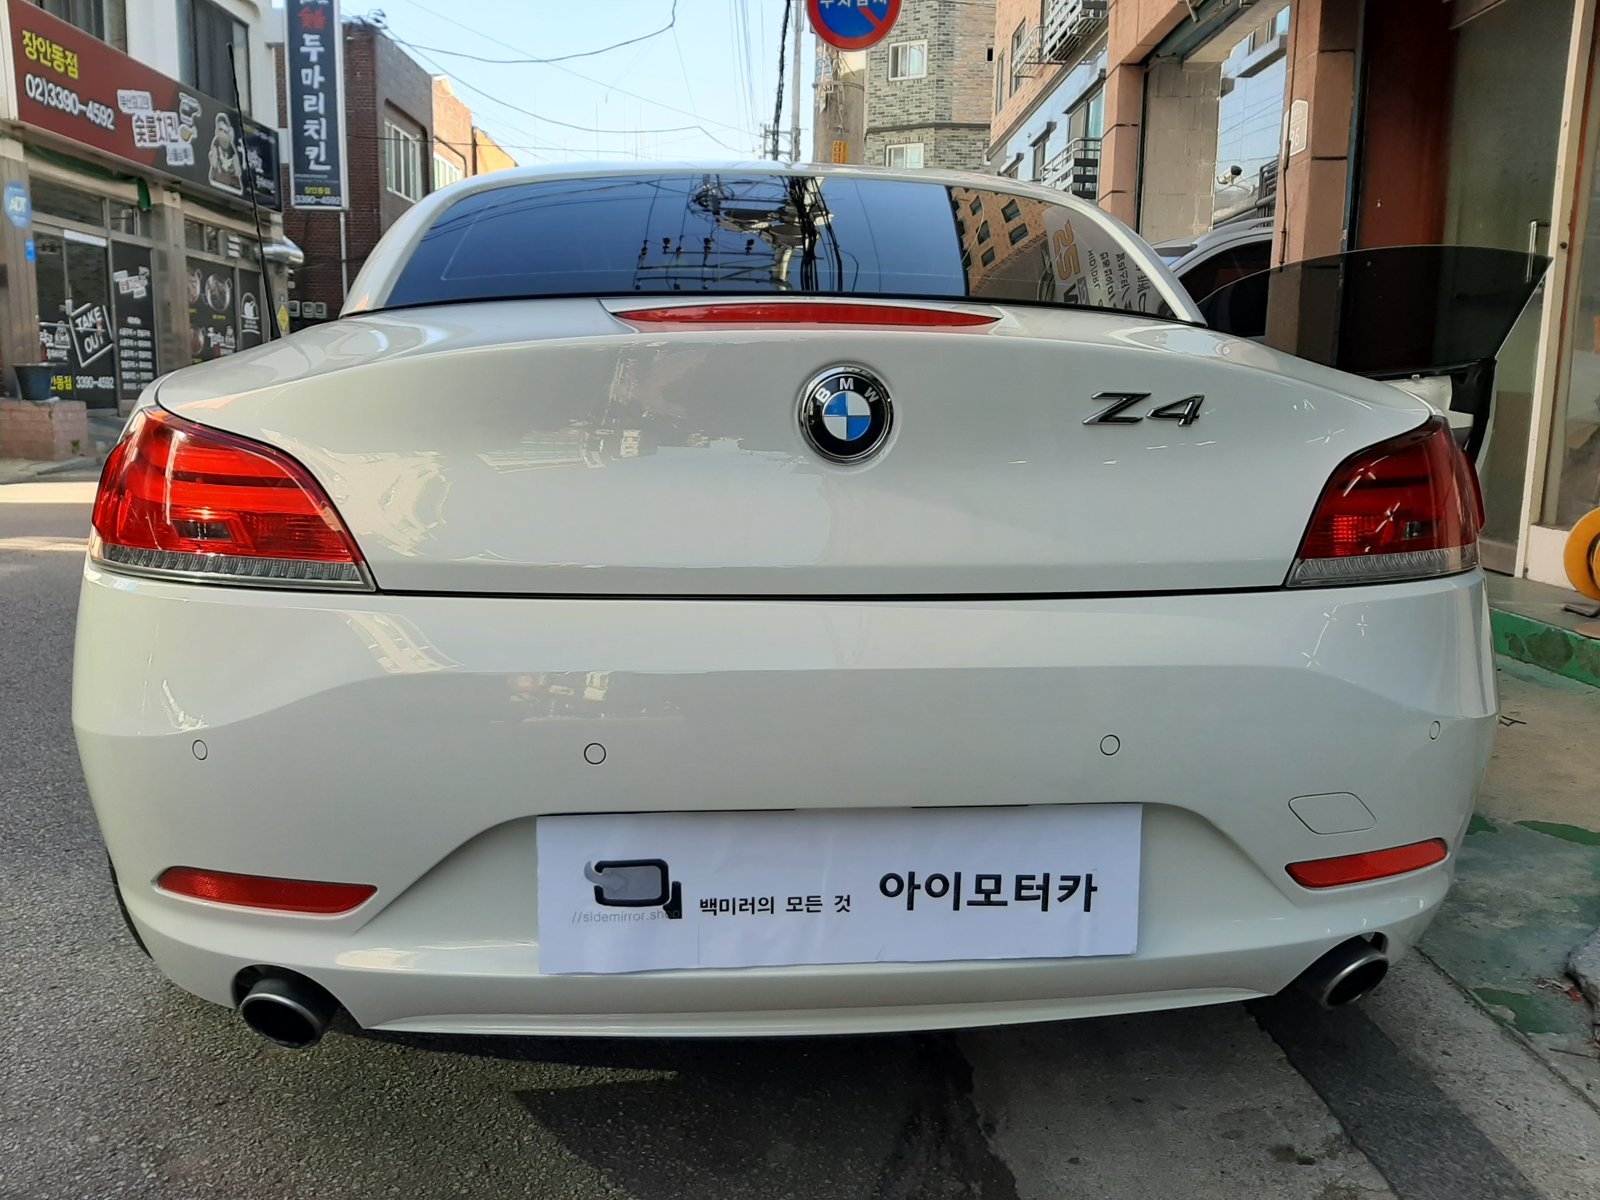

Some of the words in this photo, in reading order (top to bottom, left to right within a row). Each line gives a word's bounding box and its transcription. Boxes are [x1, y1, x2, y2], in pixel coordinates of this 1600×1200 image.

[22, 30, 79, 79] 장안동점
[25, 73, 115, 130] 02)3390-4592
[300, 33, 331, 170] 두마리치킨
[75, 306, 103, 333] TAKE
[815, 377, 879, 404] BMW
[1082, 392, 1205, 426] Z4
[699, 896, 774, 916] 백미러의
[786, 895, 823, 913] 모든
[834, 894, 851, 913] 것
[879, 871, 1098, 912] 아이모터카
